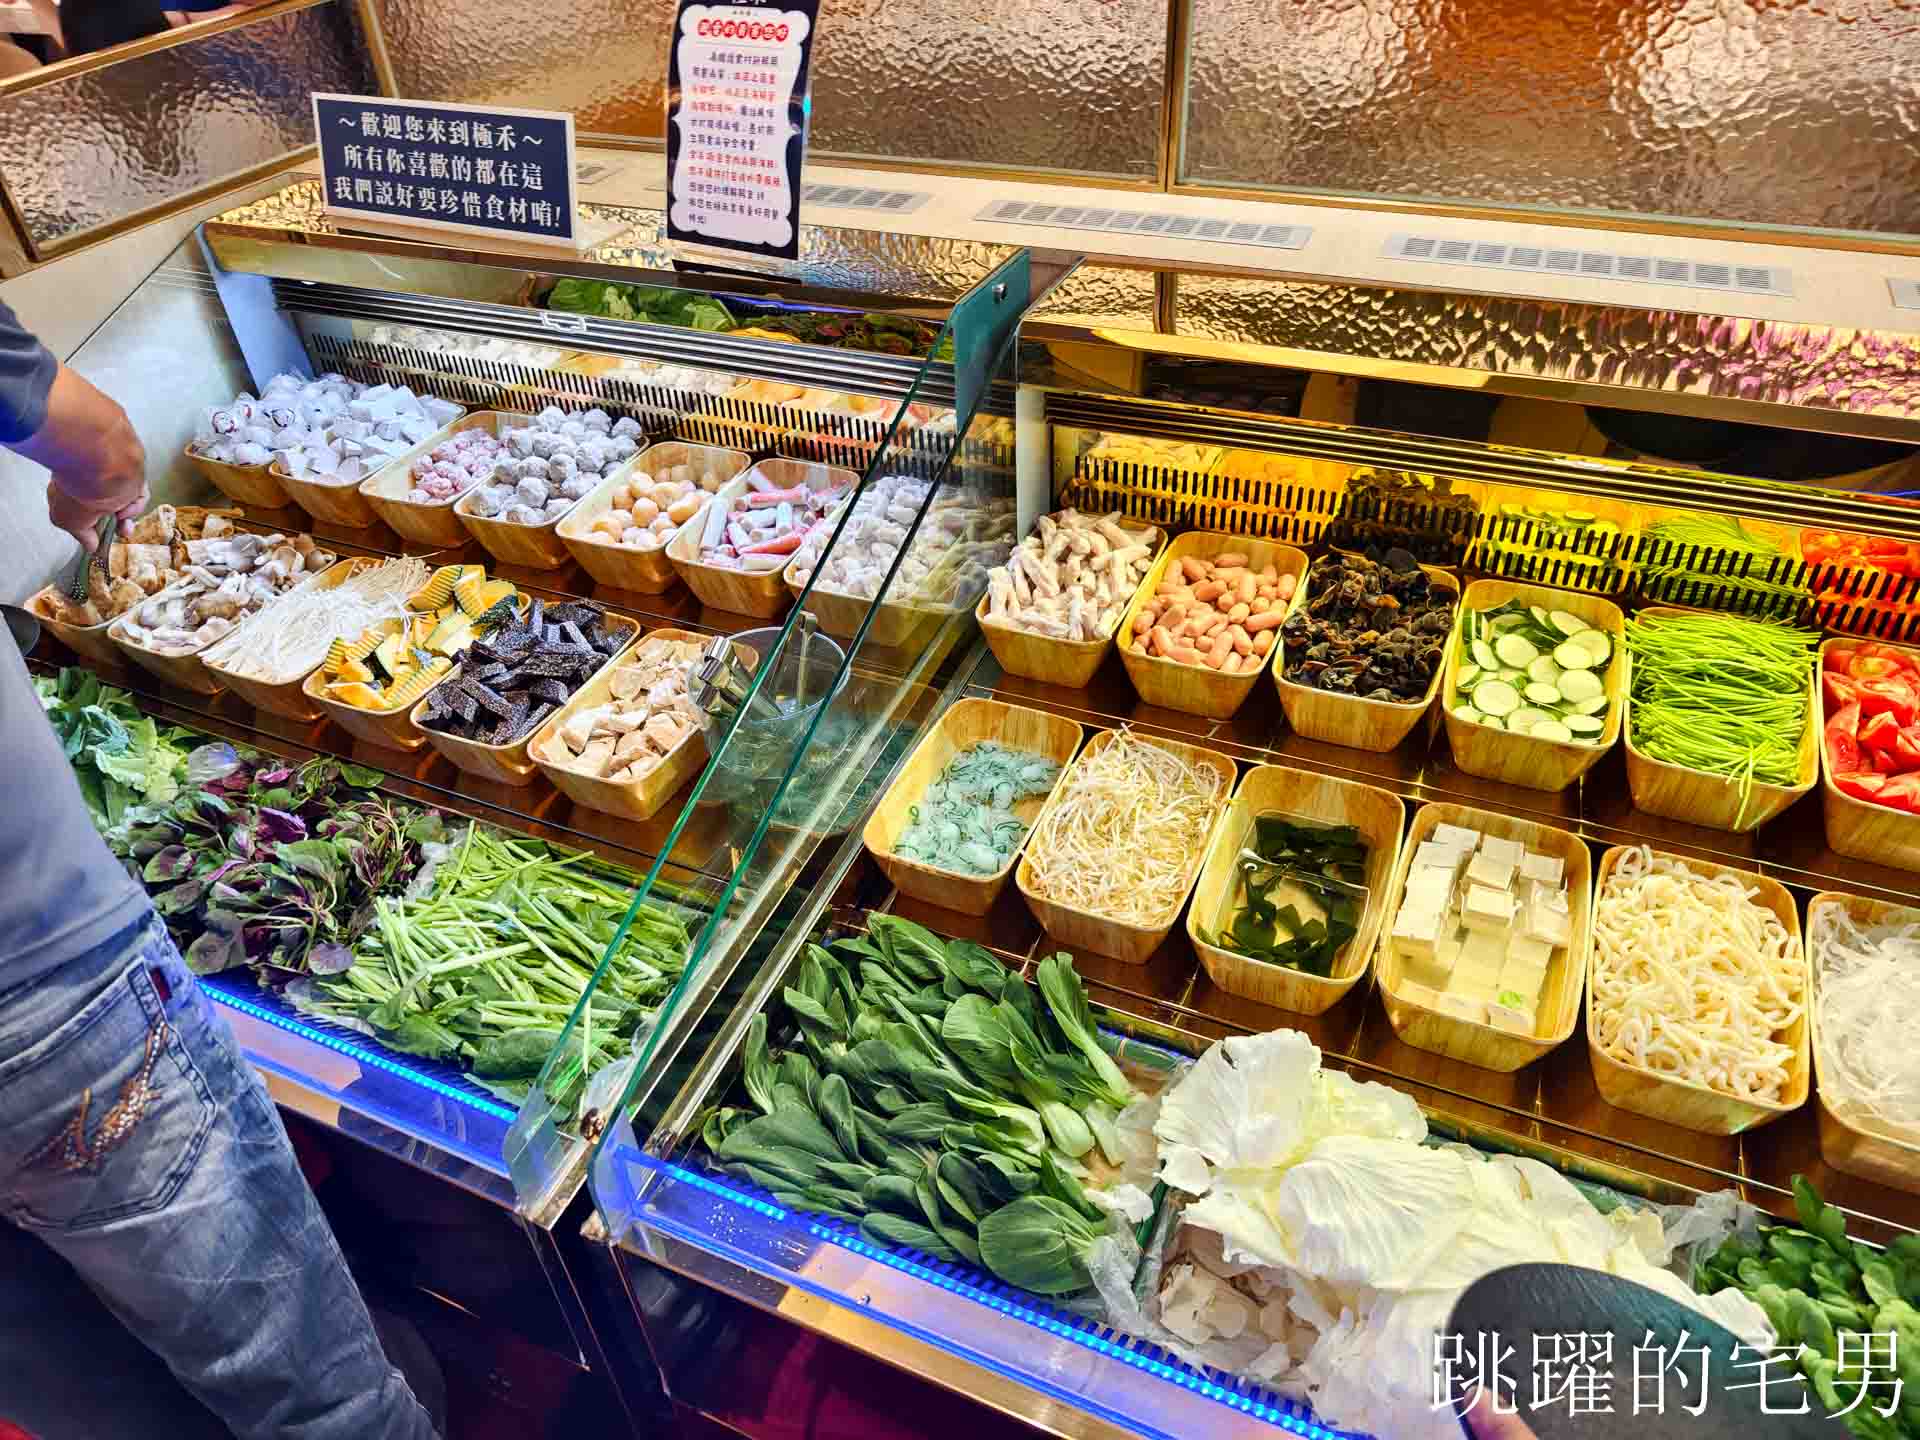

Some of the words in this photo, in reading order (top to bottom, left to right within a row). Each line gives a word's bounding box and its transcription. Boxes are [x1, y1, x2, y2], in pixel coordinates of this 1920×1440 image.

[344, 144, 543, 191] 所有你喜歡的都在這
